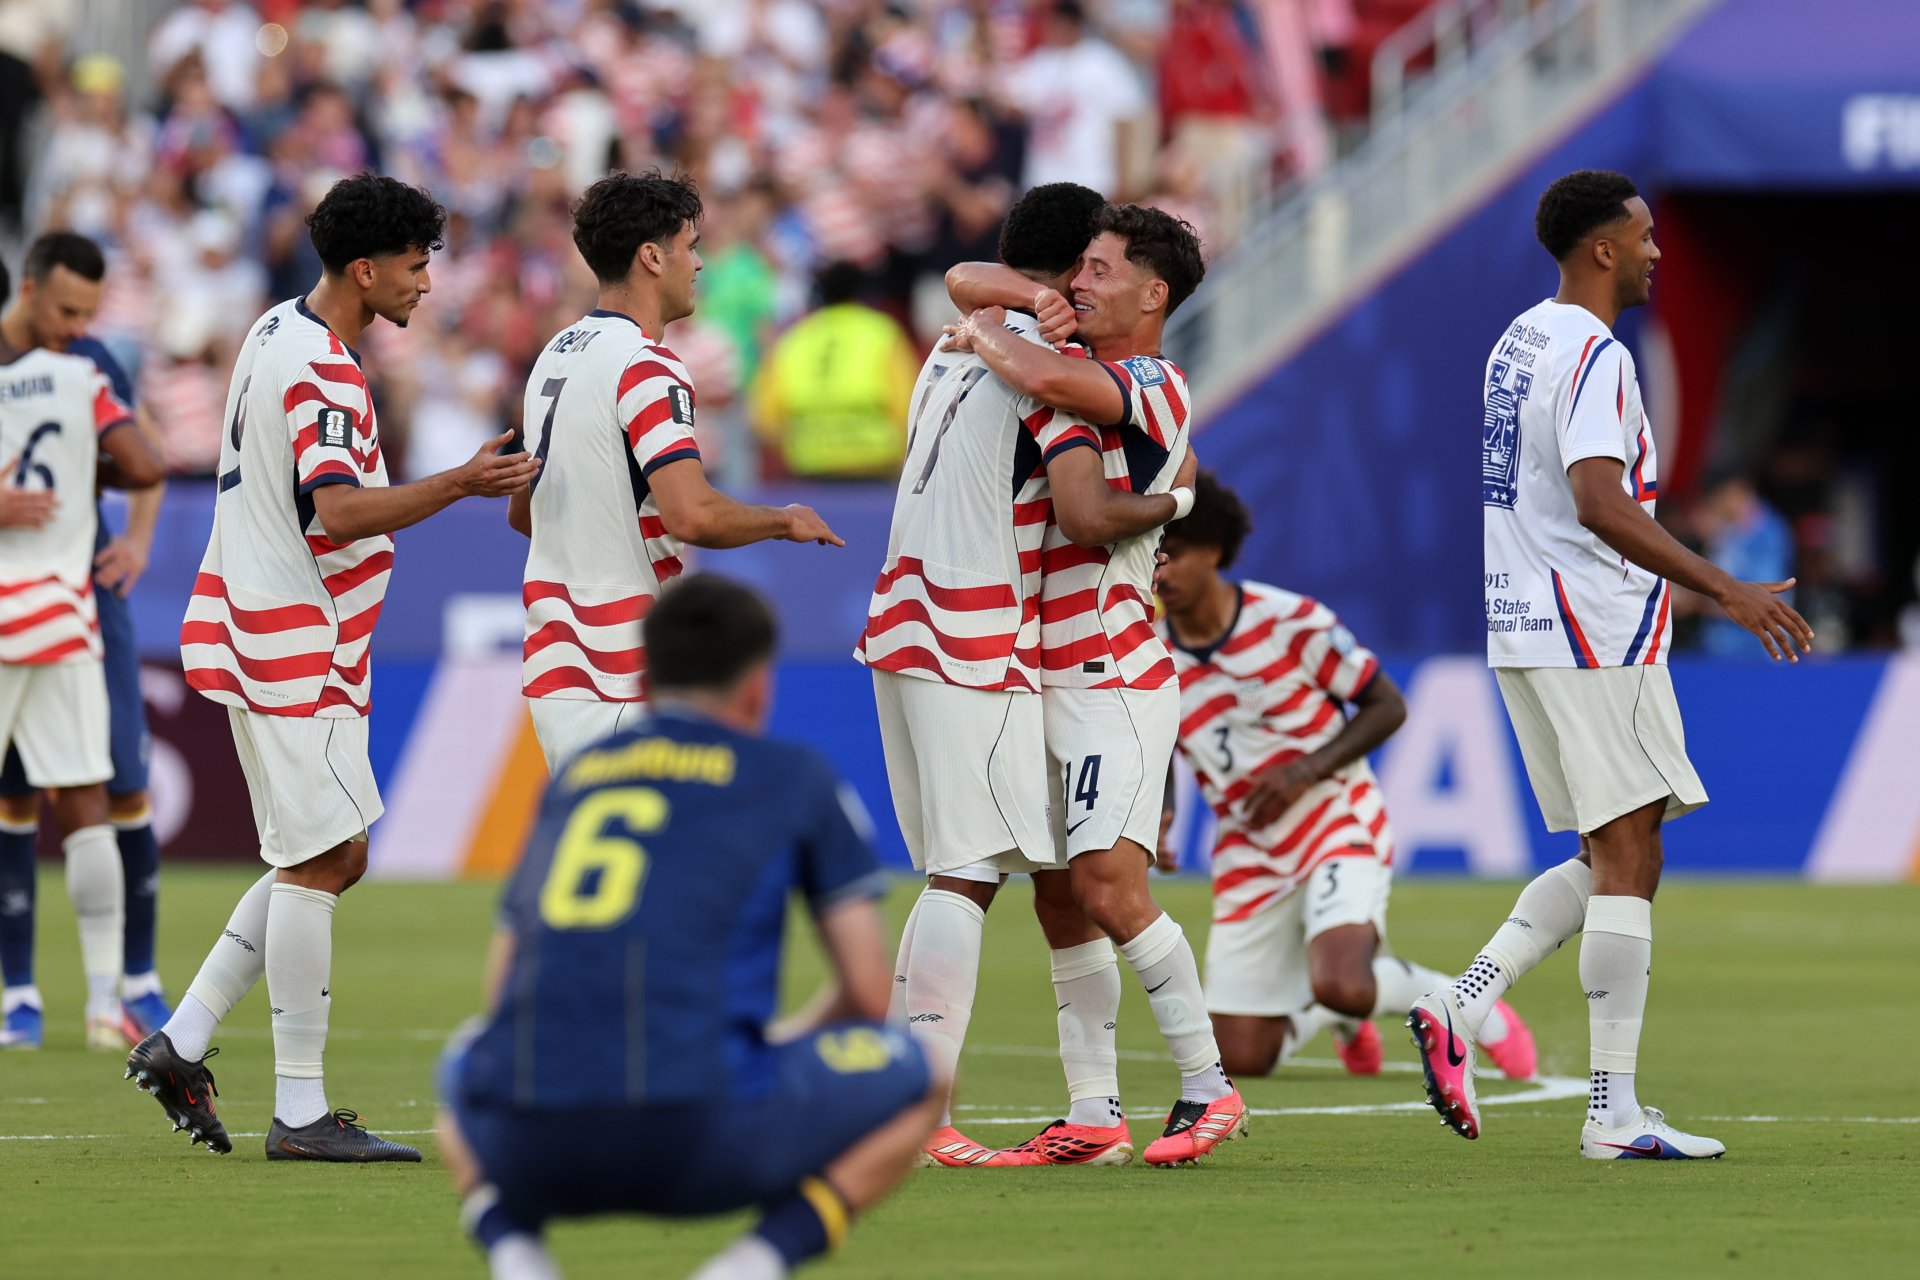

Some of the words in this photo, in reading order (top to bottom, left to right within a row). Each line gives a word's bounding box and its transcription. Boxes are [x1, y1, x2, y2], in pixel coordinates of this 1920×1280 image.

[530, 377, 568, 498] 7
[1493, 598, 1531, 615] States
[1520, 616, 1553, 632] Team
[1213, 726, 1234, 773] 3
[1065, 754, 1102, 819] 14
[540, 786, 671, 931] 6
[1319, 862, 1340, 901] 3
